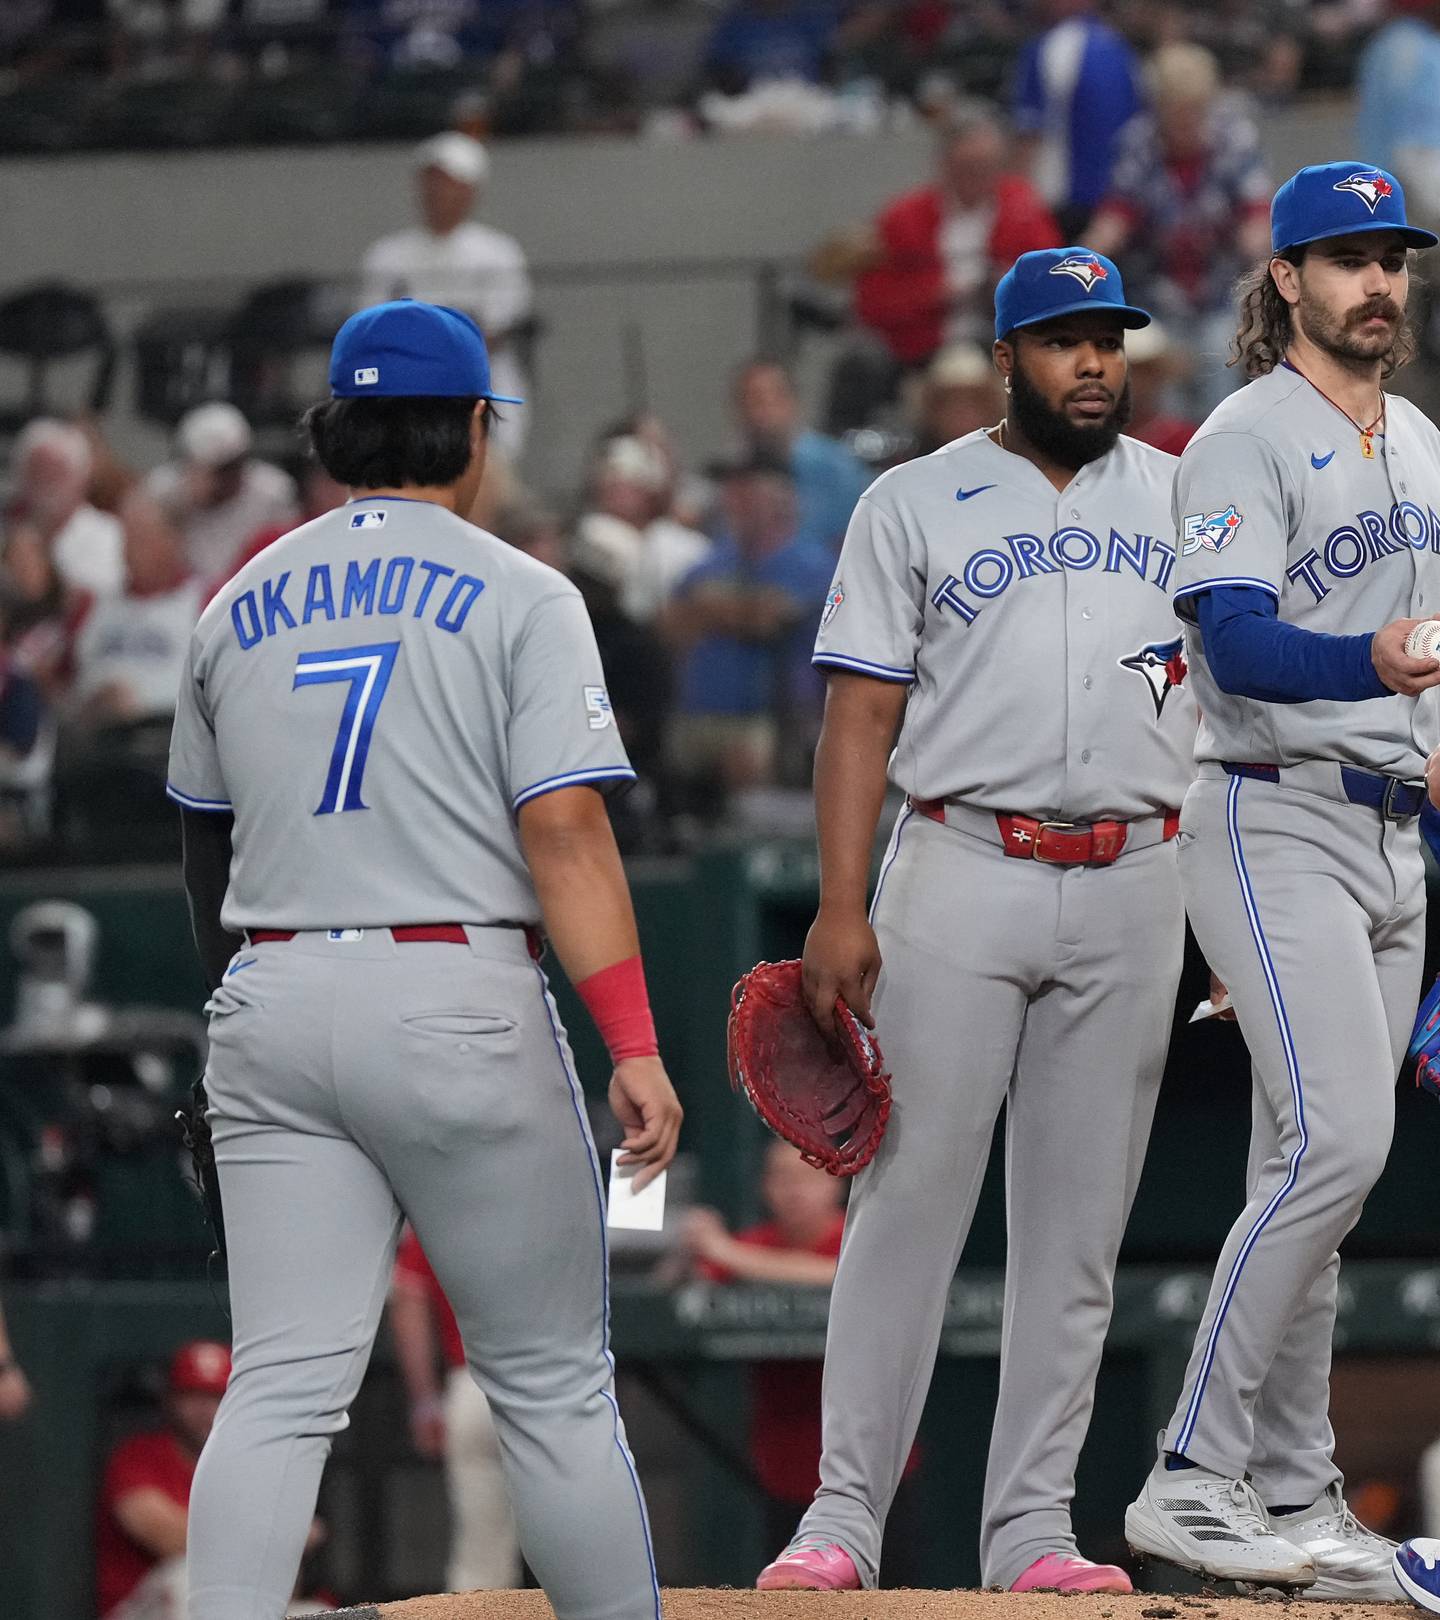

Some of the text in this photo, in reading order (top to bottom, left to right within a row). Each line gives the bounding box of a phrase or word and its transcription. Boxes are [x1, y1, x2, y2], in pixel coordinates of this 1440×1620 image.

[230, 556, 485, 650] OKAMOTO
[931, 526, 1176, 628] TORONT
[292, 641, 400, 816] 7
